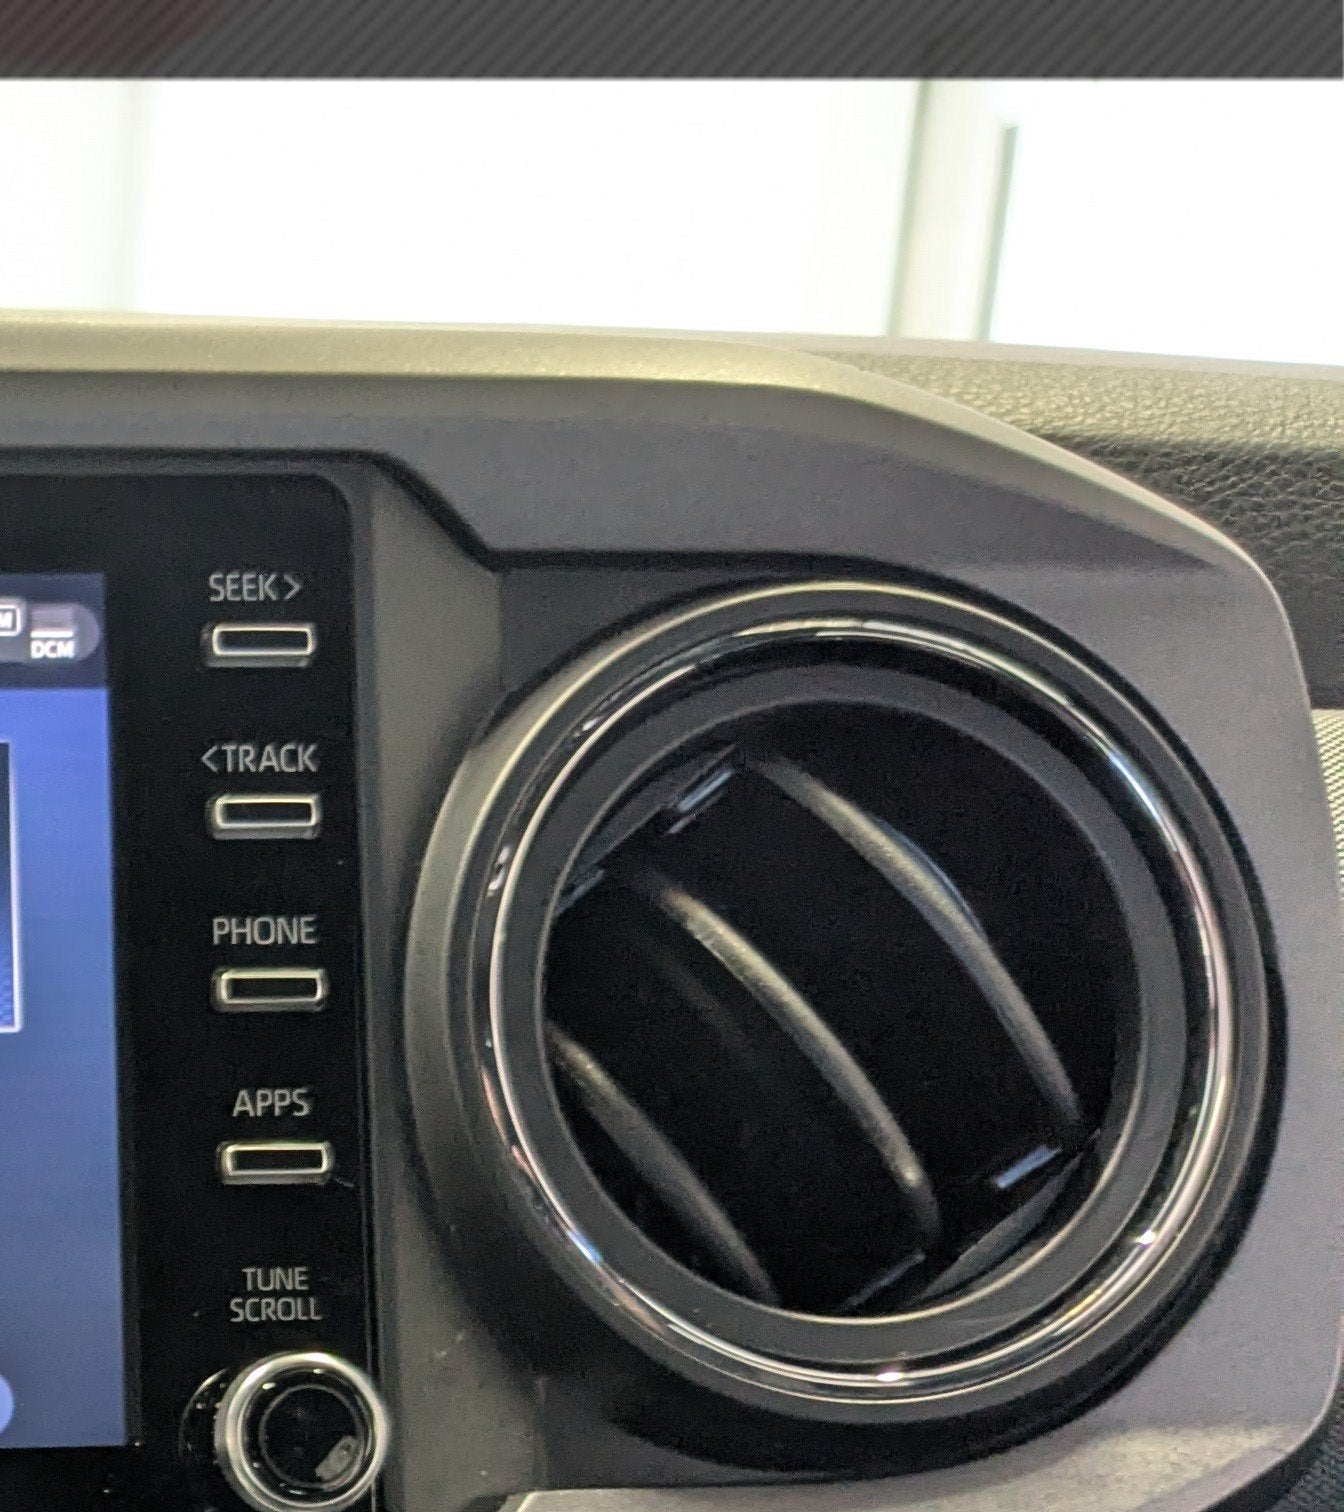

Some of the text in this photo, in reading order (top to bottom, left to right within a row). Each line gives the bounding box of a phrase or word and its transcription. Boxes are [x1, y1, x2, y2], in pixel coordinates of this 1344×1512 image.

[30, 640, 74, 658] DCM
[212, 916, 317, 946] PHONE
[232, 1087, 310, 1117] APPS
[242, 1266, 309, 1292] TUNE
[229, 1296, 322, 1323] SCROLL
